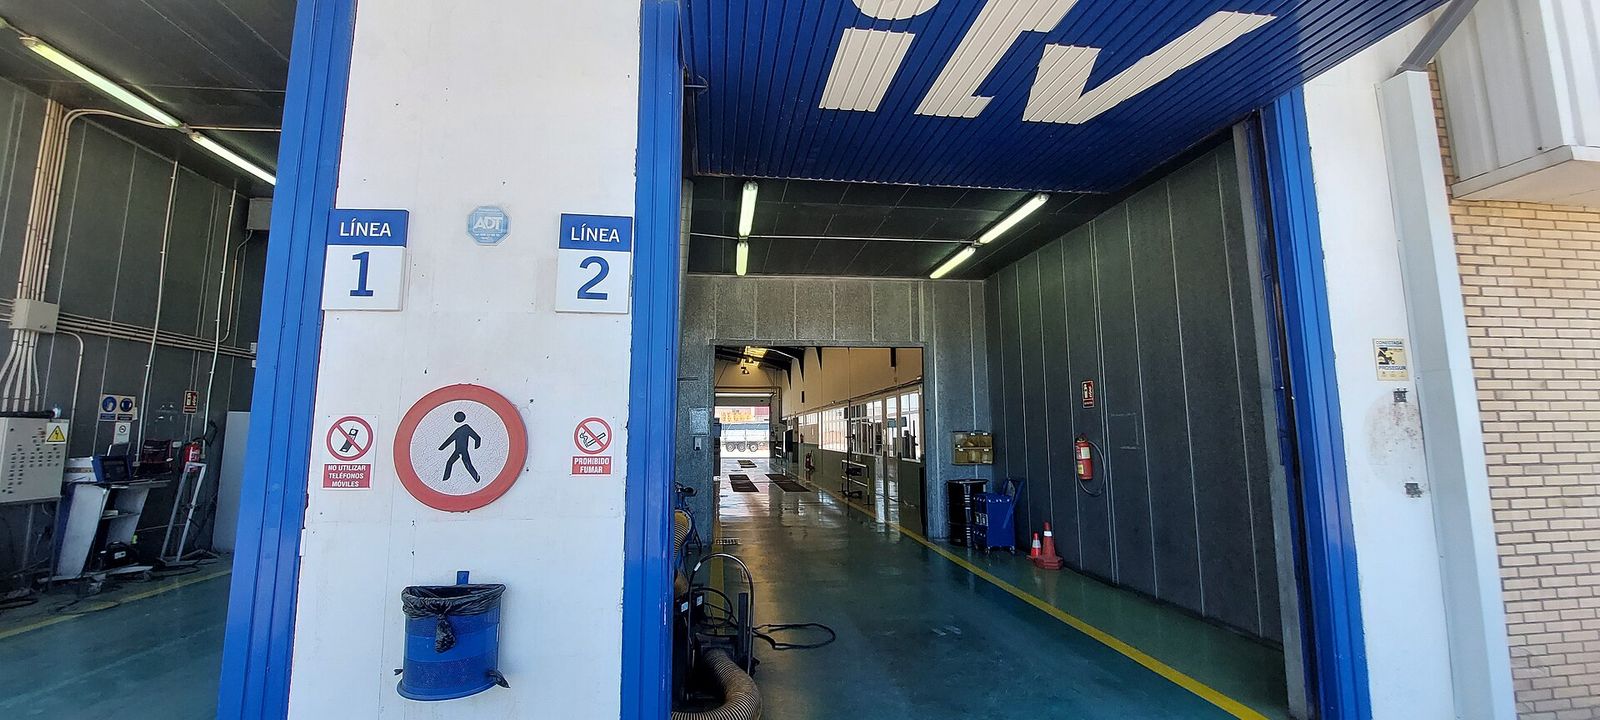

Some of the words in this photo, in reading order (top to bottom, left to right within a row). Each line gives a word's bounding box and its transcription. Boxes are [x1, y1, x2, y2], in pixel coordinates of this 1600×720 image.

[819, 0, 1277, 125] itv
[340, 217, 392, 237] LÍNEA
[473, 215, 503, 230] ADT
[571, 223, 620, 243] LÍNEA
[349, 251, 374, 297] 1
[576, 255, 610, 301] 2
[574, 457, 610, 465] PROHIBIDO
[329, 471, 364, 479] TELÉFONOS
